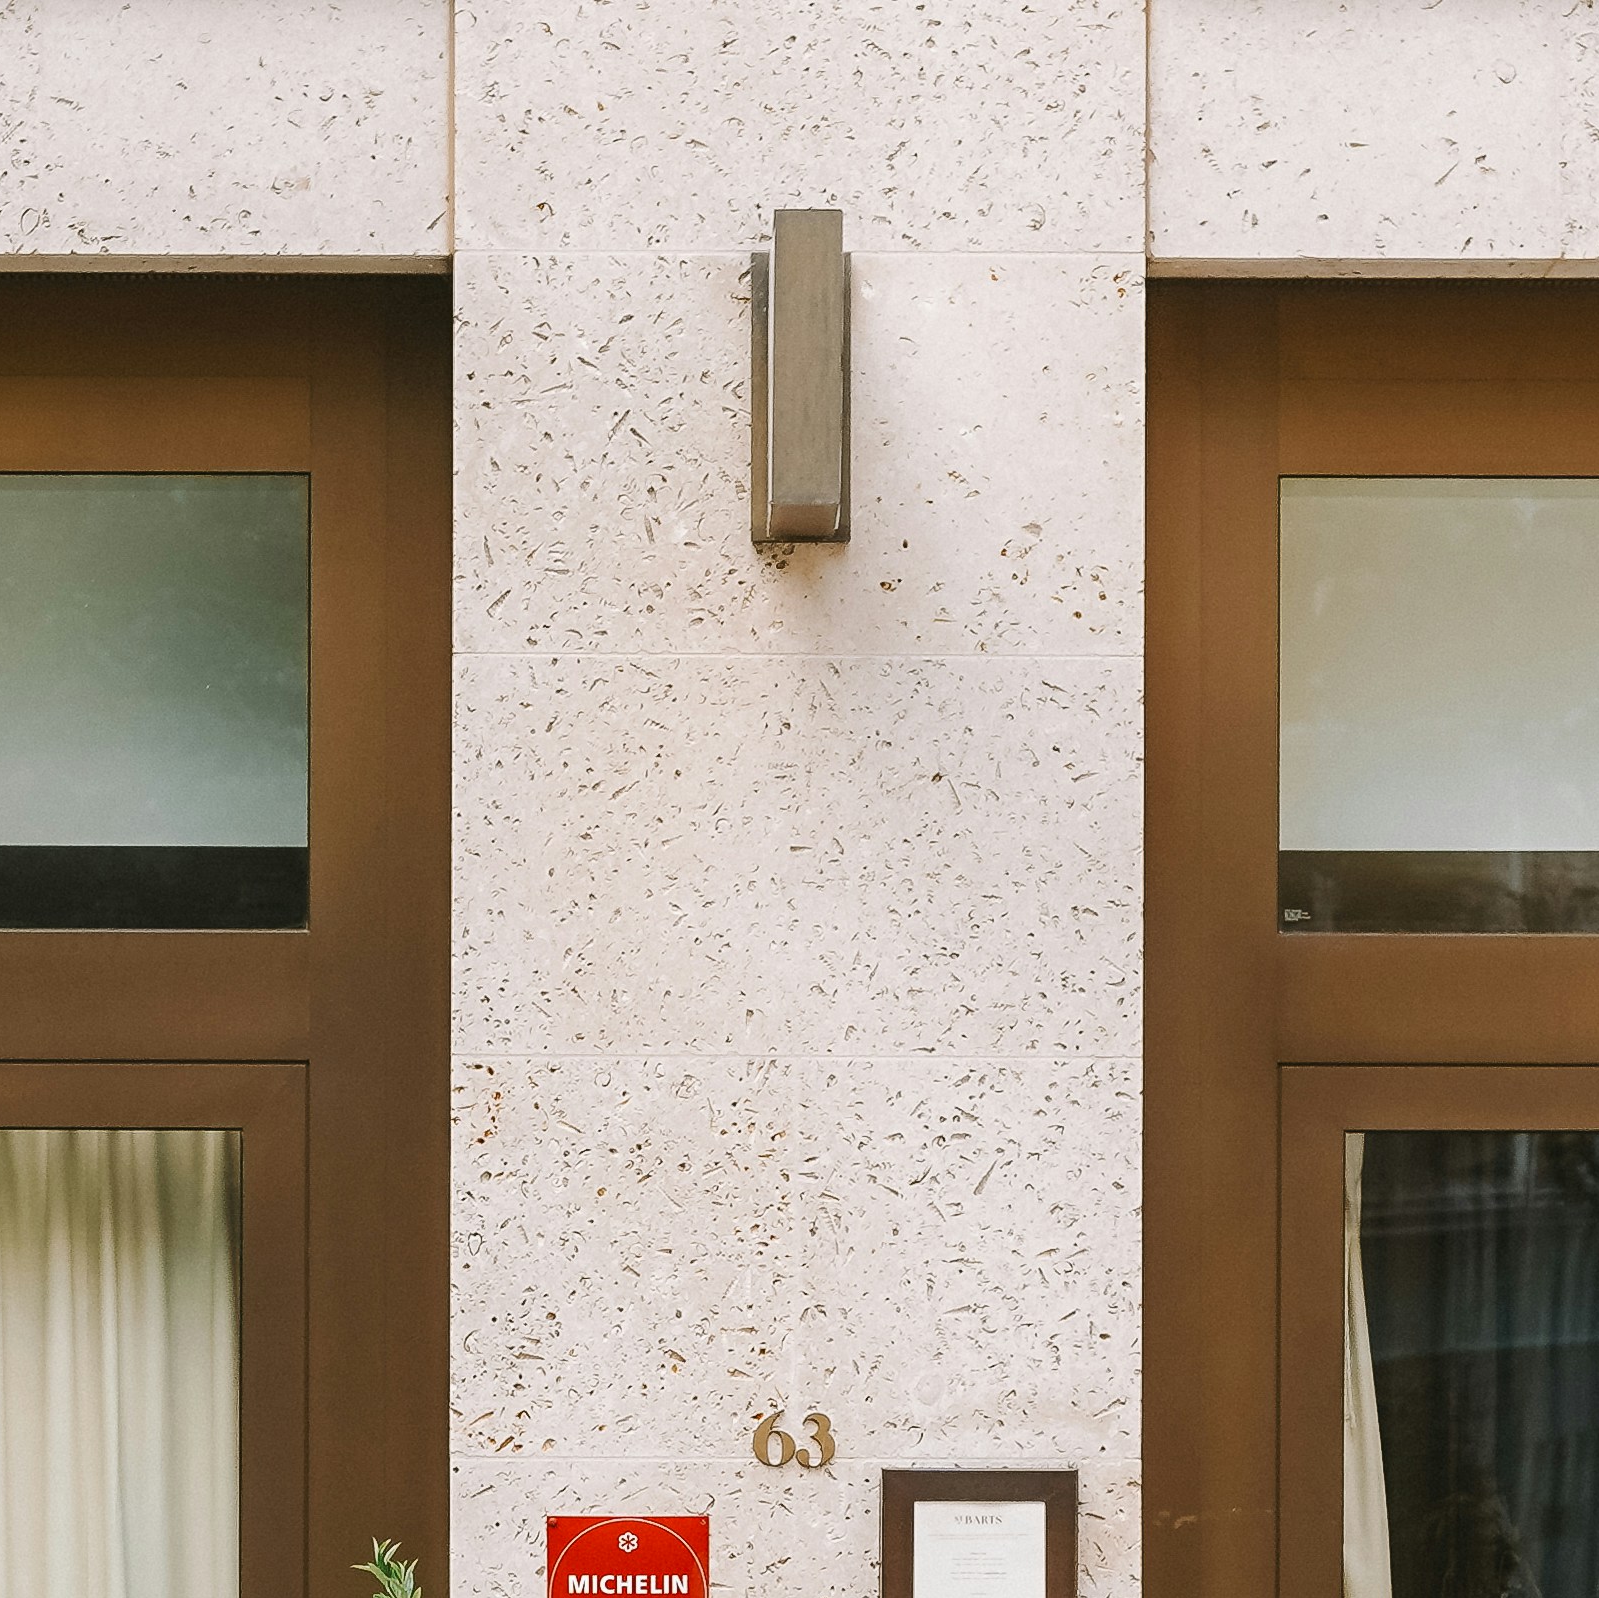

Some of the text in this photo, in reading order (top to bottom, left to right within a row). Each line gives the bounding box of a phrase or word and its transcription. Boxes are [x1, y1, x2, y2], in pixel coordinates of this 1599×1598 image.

[753, 1409, 835, 1468] 63
[965, 1515, 1003, 1525] BARTS
[568, 1574, 689, 1595] MICHELIN
